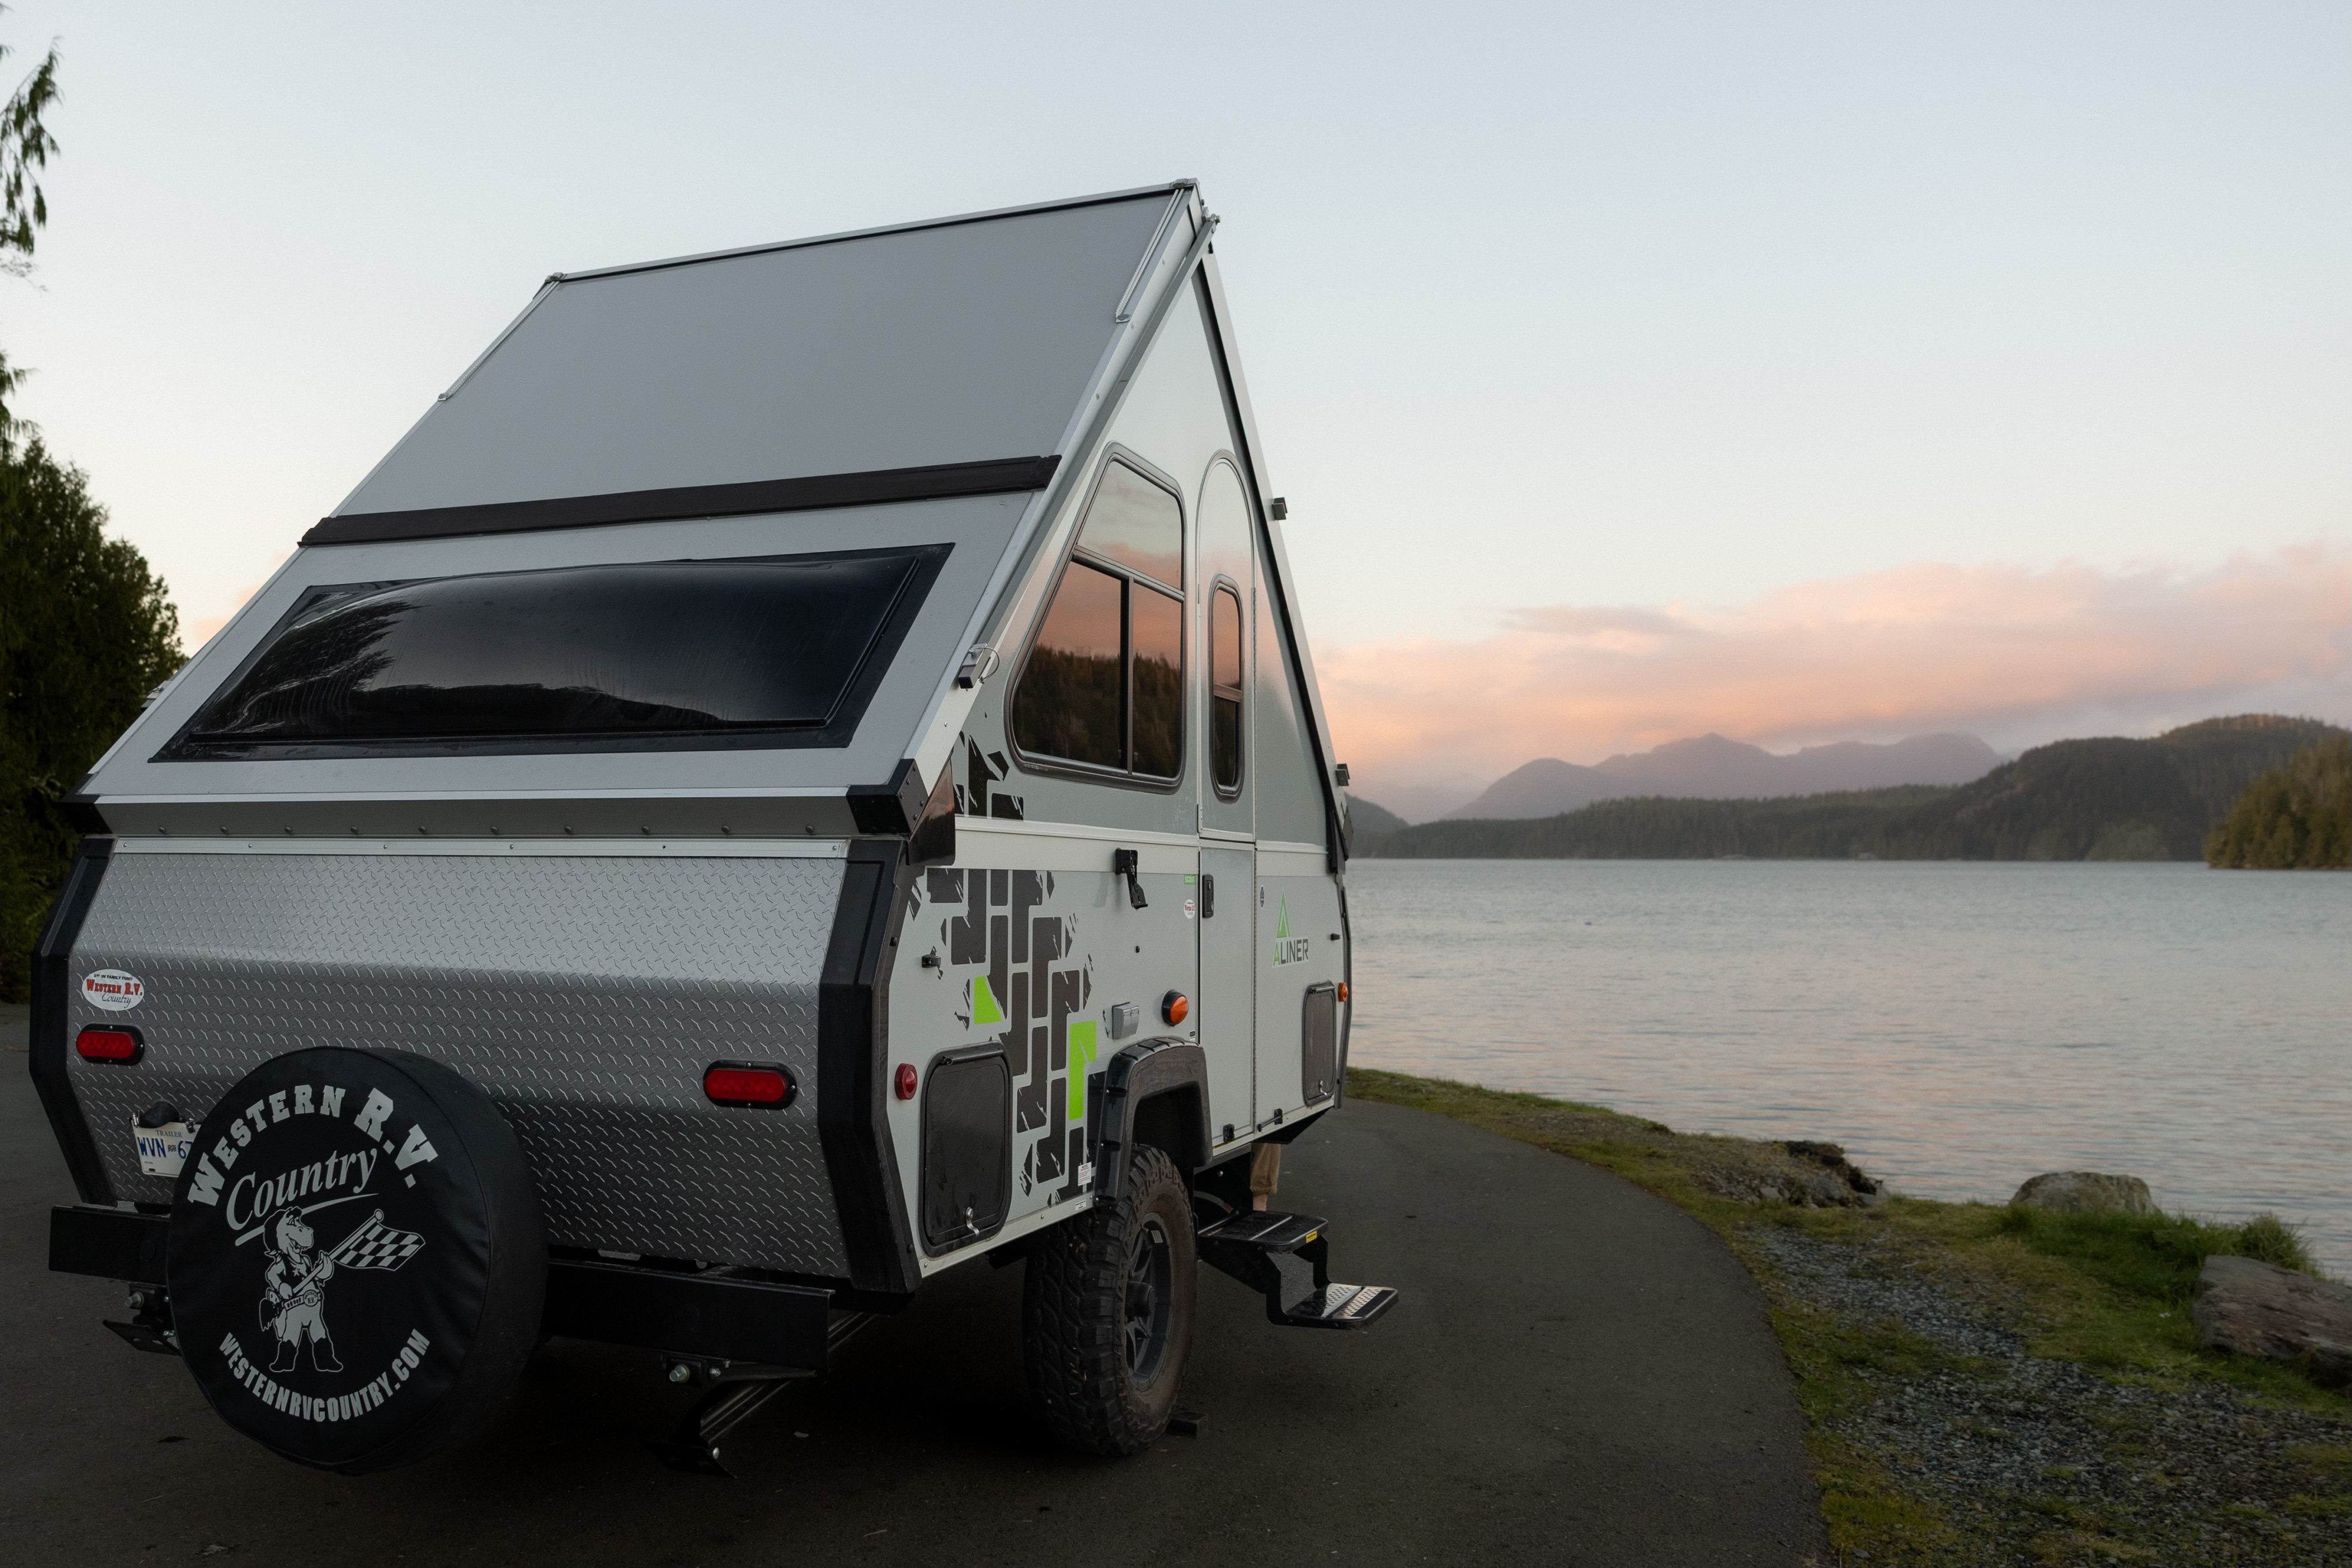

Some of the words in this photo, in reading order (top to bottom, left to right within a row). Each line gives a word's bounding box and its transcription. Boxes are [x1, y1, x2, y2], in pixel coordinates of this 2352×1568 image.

[1273, 938, 1308, 966] ALINER
[86, 978, 122, 994] WESTERN
[125, 982, 143, 996] R.V.
[102, 991, 132, 1008] Country
[155, 1129, 183, 1138] TRAILER
[187, 1084, 346, 1206] WESTERN
[354, 1087, 439, 1188] R.V.
[137, 1136, 166, 1158] WVN
[226, 1148, 377, 1231] Country
[219, 1328, 430, 1422] WESTERNRVCOUNTRY.COM
